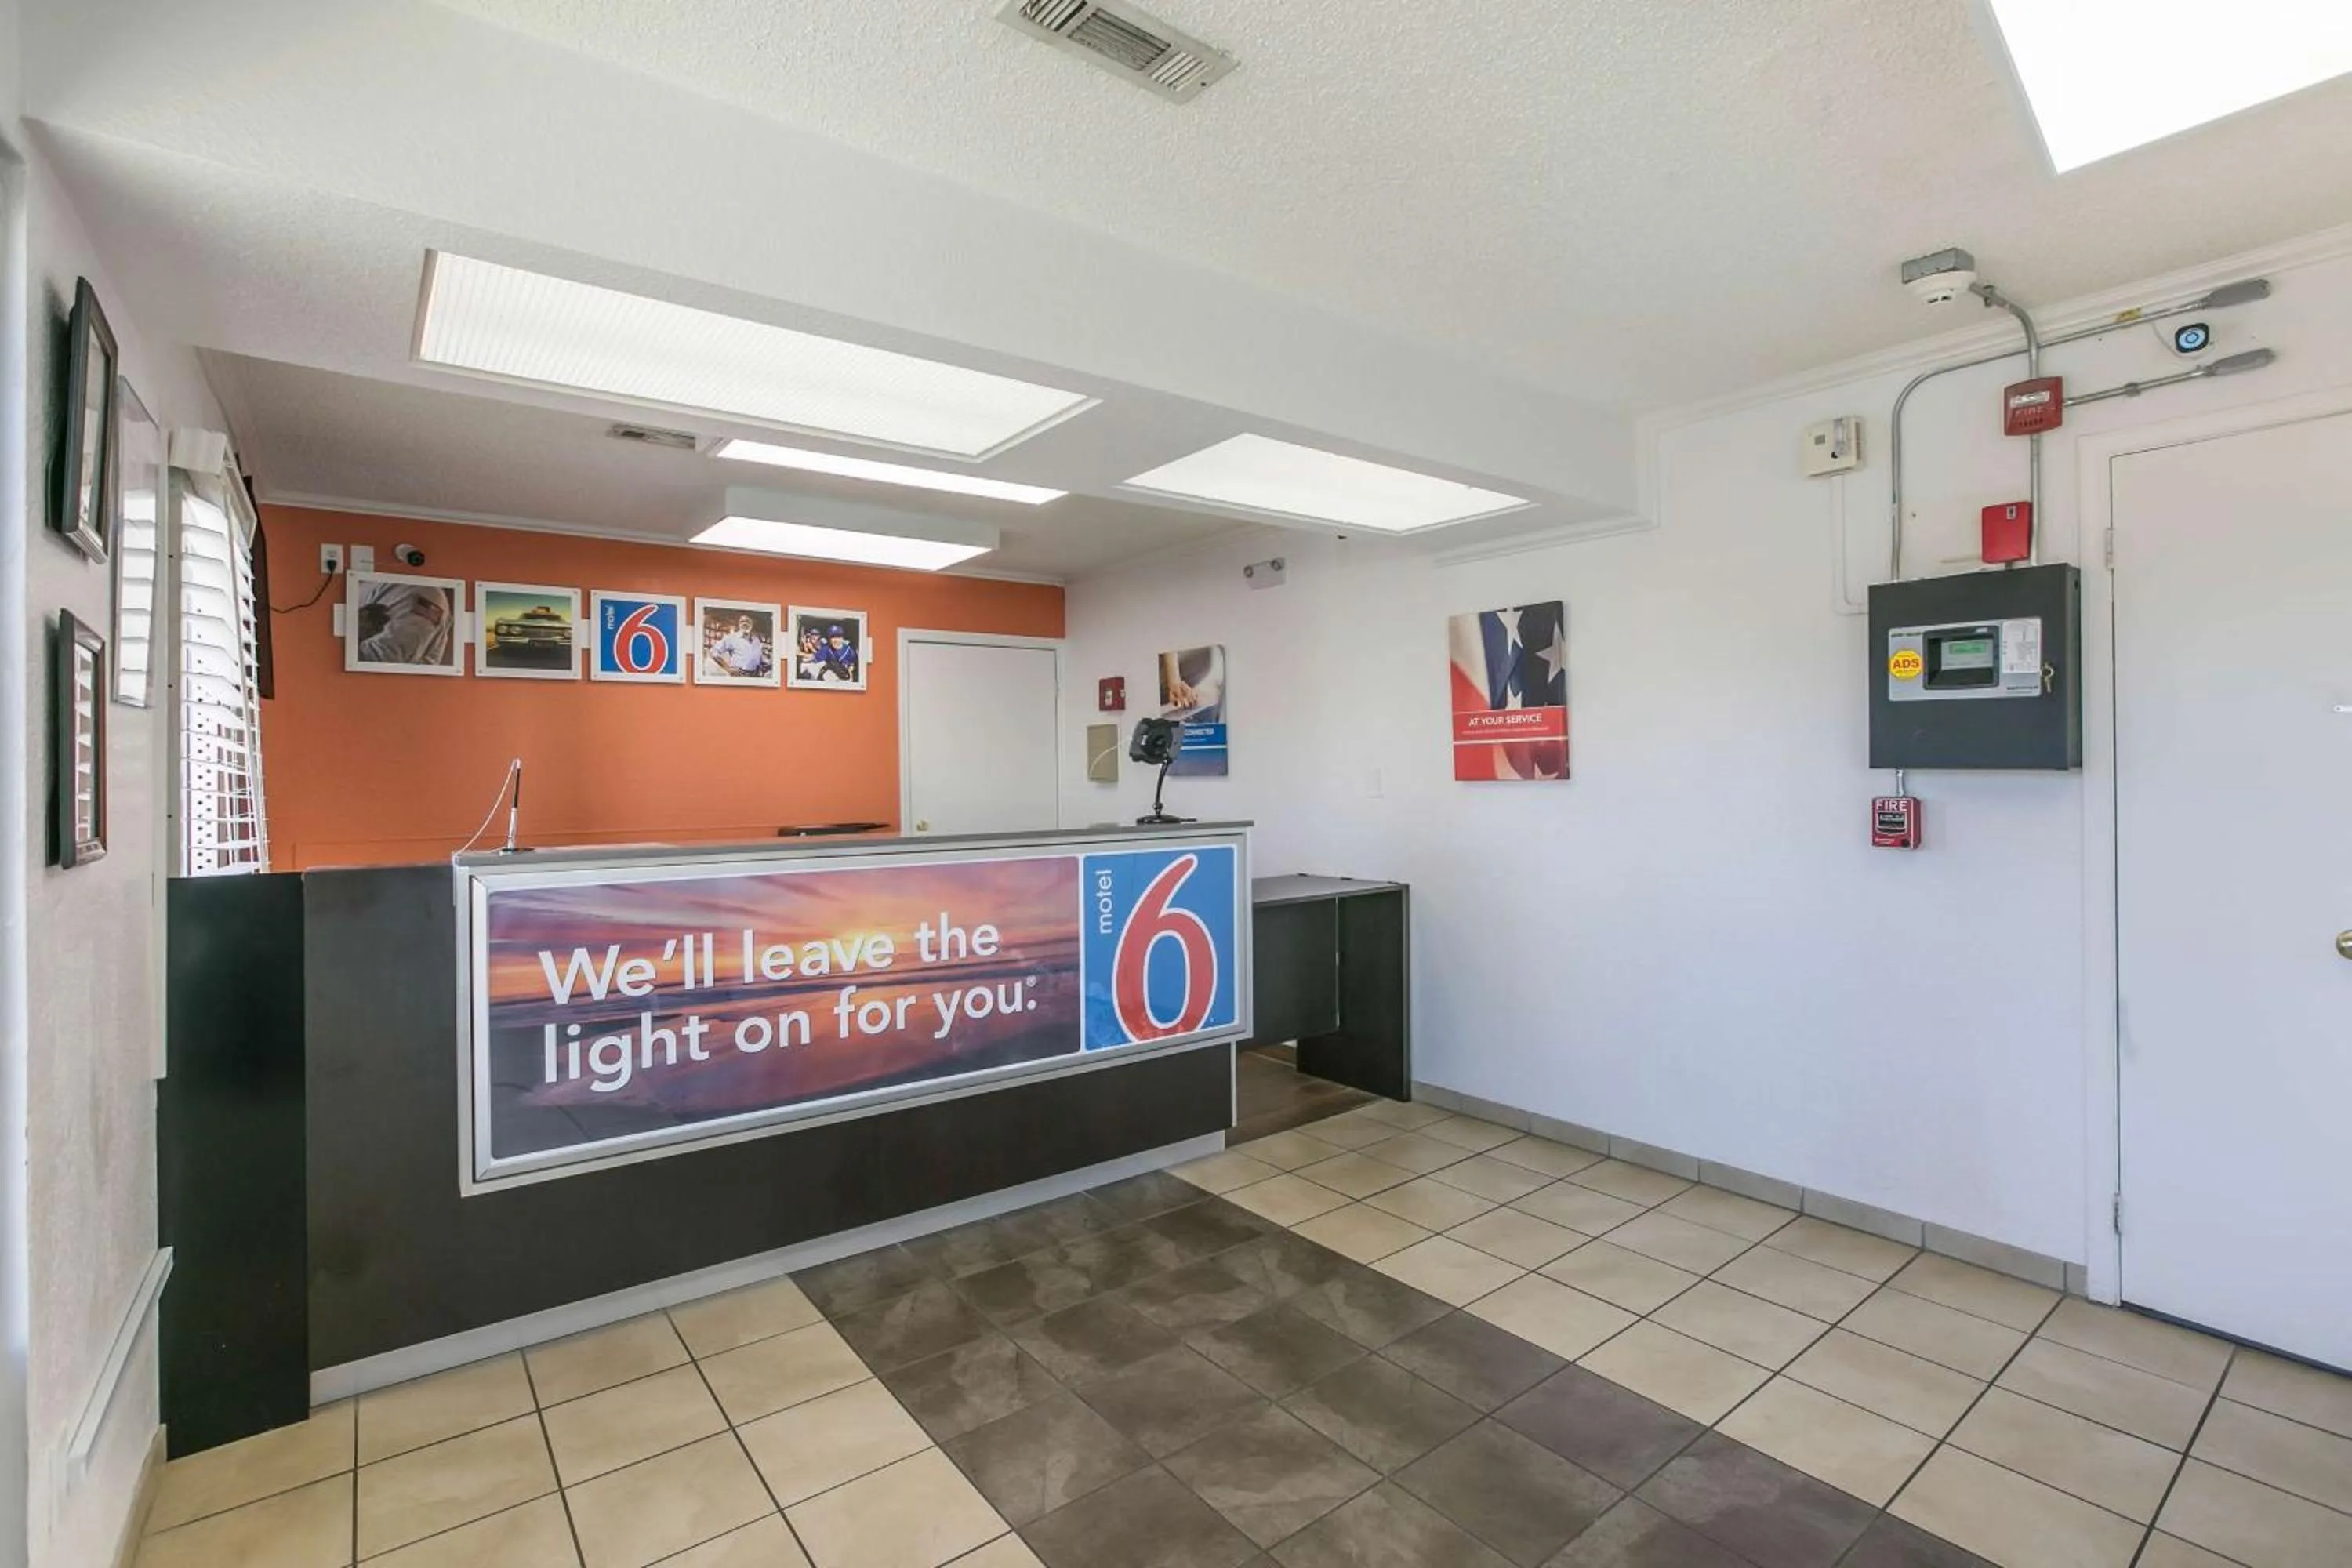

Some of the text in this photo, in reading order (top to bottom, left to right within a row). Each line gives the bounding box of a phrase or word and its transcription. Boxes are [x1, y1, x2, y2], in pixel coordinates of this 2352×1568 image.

[614, 604, 669, 675] 6
[1893, 658, 1920, 669] ADS
[1468, 713, 1543, 727] AT YOUR SERVICE
[1876, 799, 1907, 811] FIRE
[1095, 869, 1113, 934] motel
[538, 912, 1001, 1006] We'll leave the
[1112, 853, 1218, 1043] 6
[543, 1011, 710, 1093] light
[734, 1010, 811, 1053] on
[833, 985, 917, 1040] for
